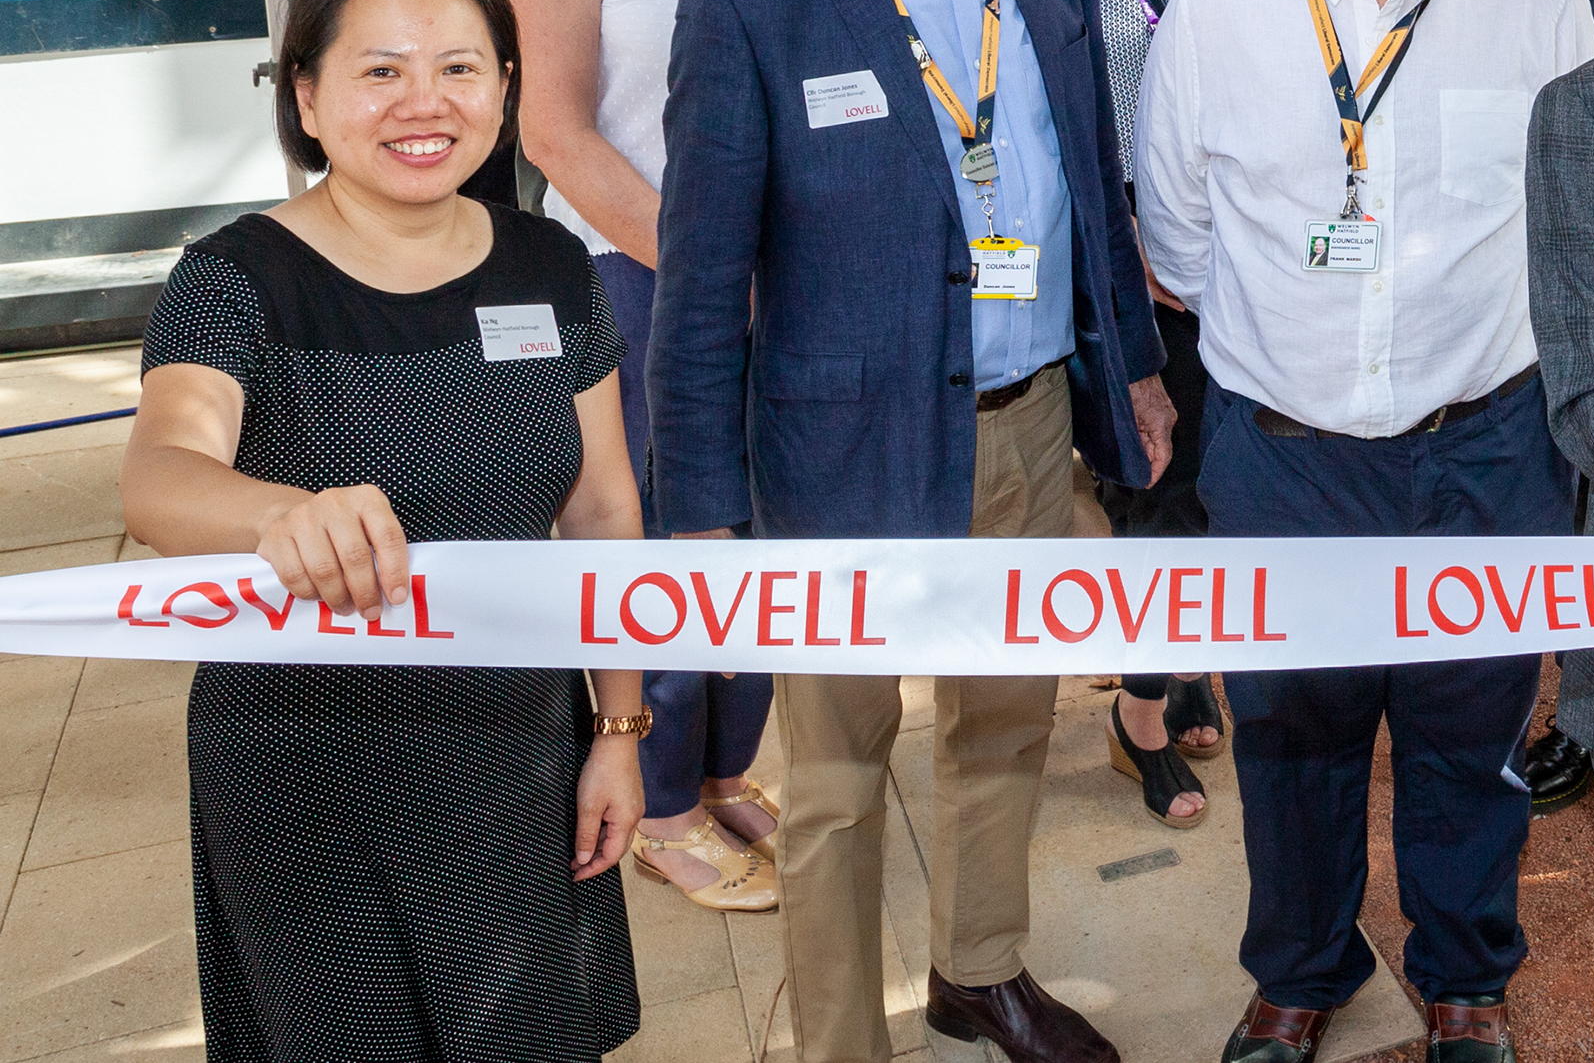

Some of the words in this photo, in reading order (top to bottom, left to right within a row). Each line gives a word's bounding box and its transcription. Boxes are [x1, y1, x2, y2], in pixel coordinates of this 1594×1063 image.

[1322, 27, 1330, 42] Liberal
[1326, 42, 1335, 66] Democrats
[1373, 50, 1386, 66] Liberal
[1382, 31, 1399, 53] Democrats
[928, 68, 946, 92] Democrats
[818, 86, 840, 94] Duncan
[943, 90, 956, 106] Liberal
[845, 104, 882, 117] LOVELL
[1331, 237, 1374, 245] COUNCILLOR
[520, 342, 556, 353] LOVELL
[580, 570, 887, 646] LOVELL
[1005, 568, 1287, 644] LOVELL
